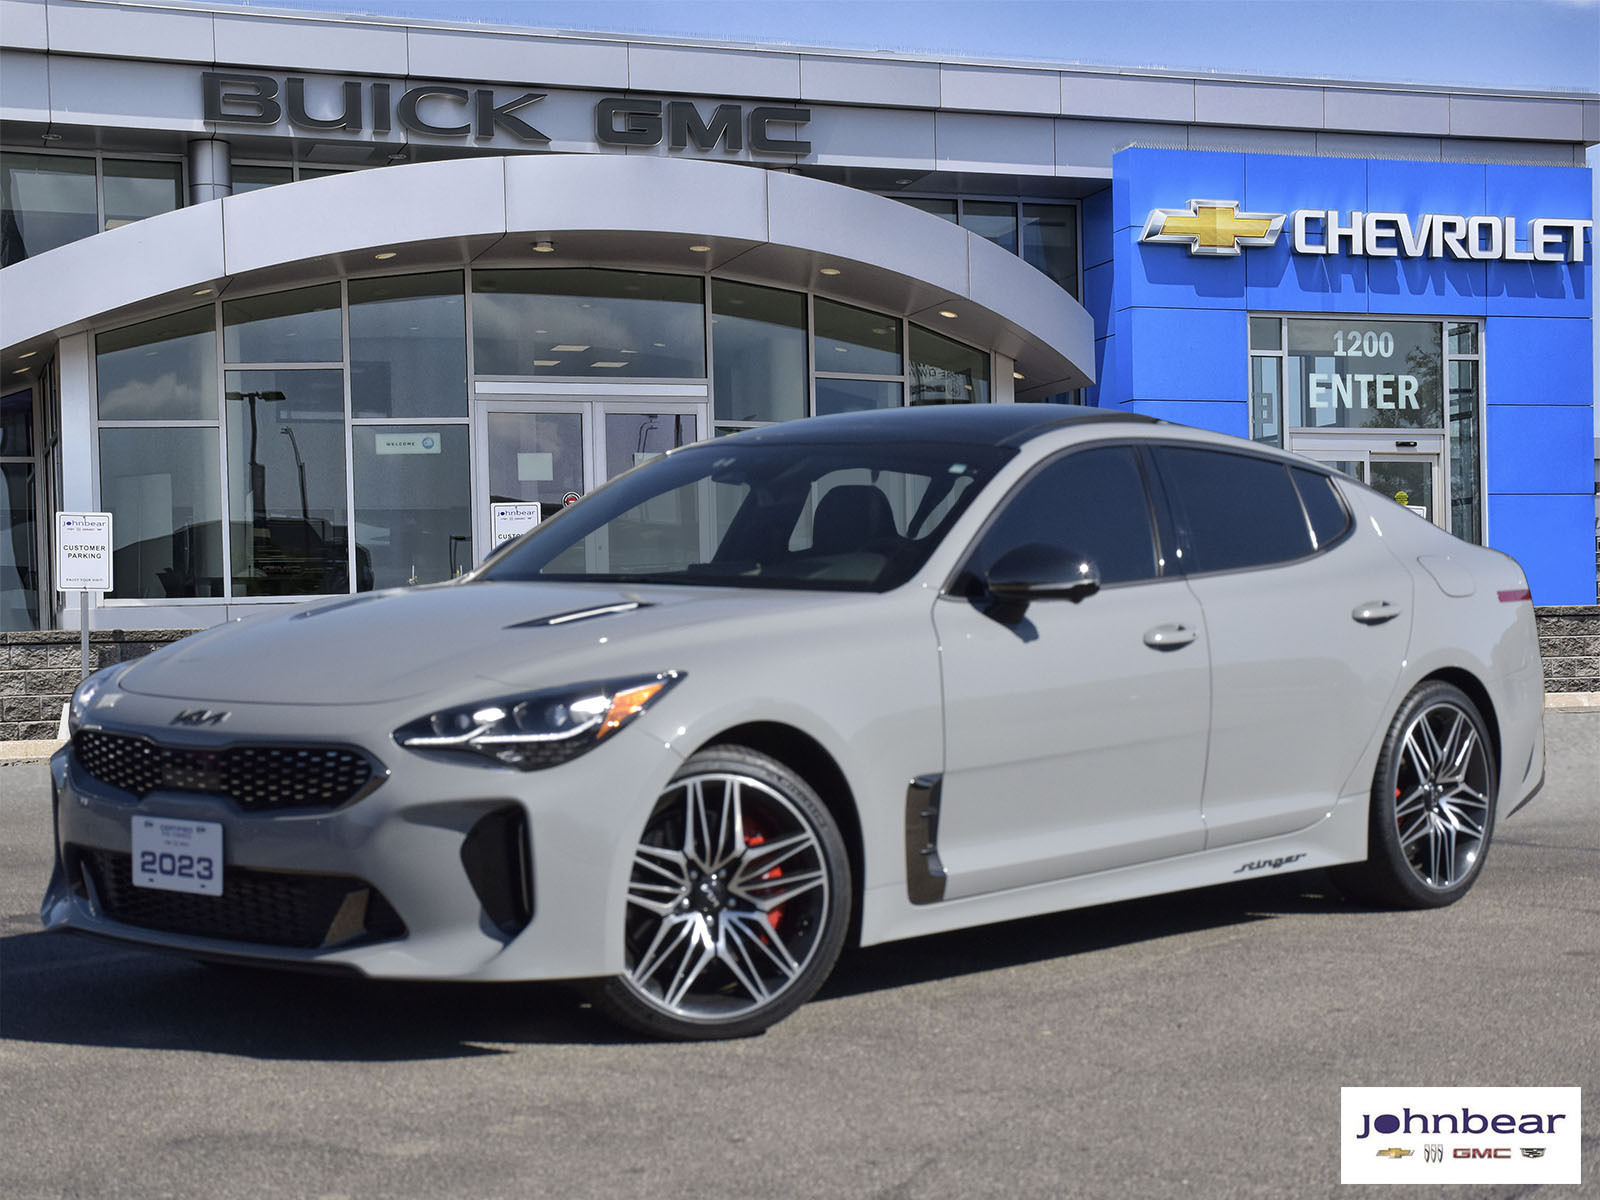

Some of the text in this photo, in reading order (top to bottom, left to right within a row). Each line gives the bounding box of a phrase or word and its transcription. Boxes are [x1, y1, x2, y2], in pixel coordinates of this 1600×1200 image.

[202, 71, 812, 156] BUICK GMC
[1291, 208, 1593, 263] CHEVROLET
[1333, 330, 1394, 358] 1200
[1308, 372, 1420, 410] ENTER
[63, 544, 106, 552] CUSTOMER
[67, 552, 102, 560] PARKING
[140, 850, 213, 880] 2023
